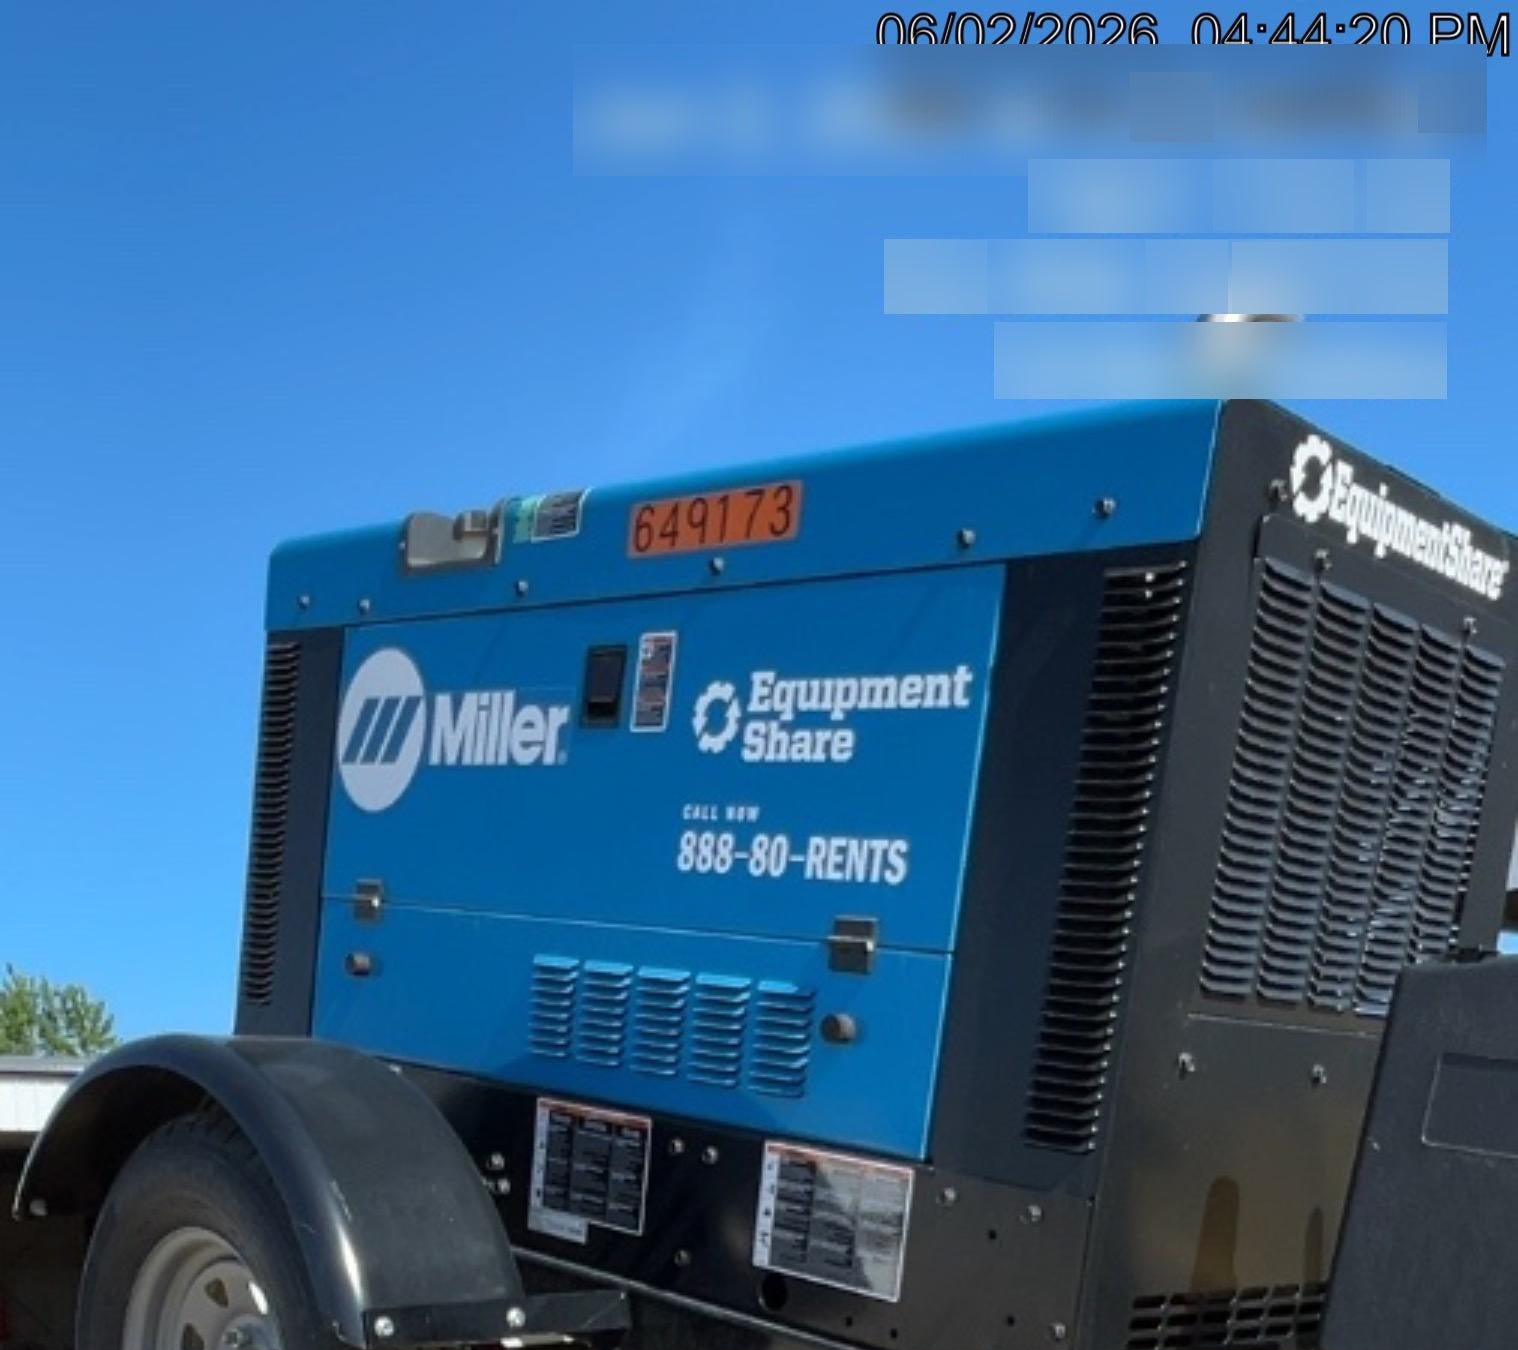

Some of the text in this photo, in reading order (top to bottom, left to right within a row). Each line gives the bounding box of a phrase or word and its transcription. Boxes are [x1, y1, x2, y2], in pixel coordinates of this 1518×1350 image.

[633, 485, 794, 553] 649173
[1328, 460, 1511, 602] EquipmentShare
[746, 664, 974, 722] Equipment
[428, 688, 571, 767] Miller
[740, 720, 856, 763] Share
[682, 803, 761, 823] CALL NOW
[676, 830, 909, 886] 888-80-RENTS
